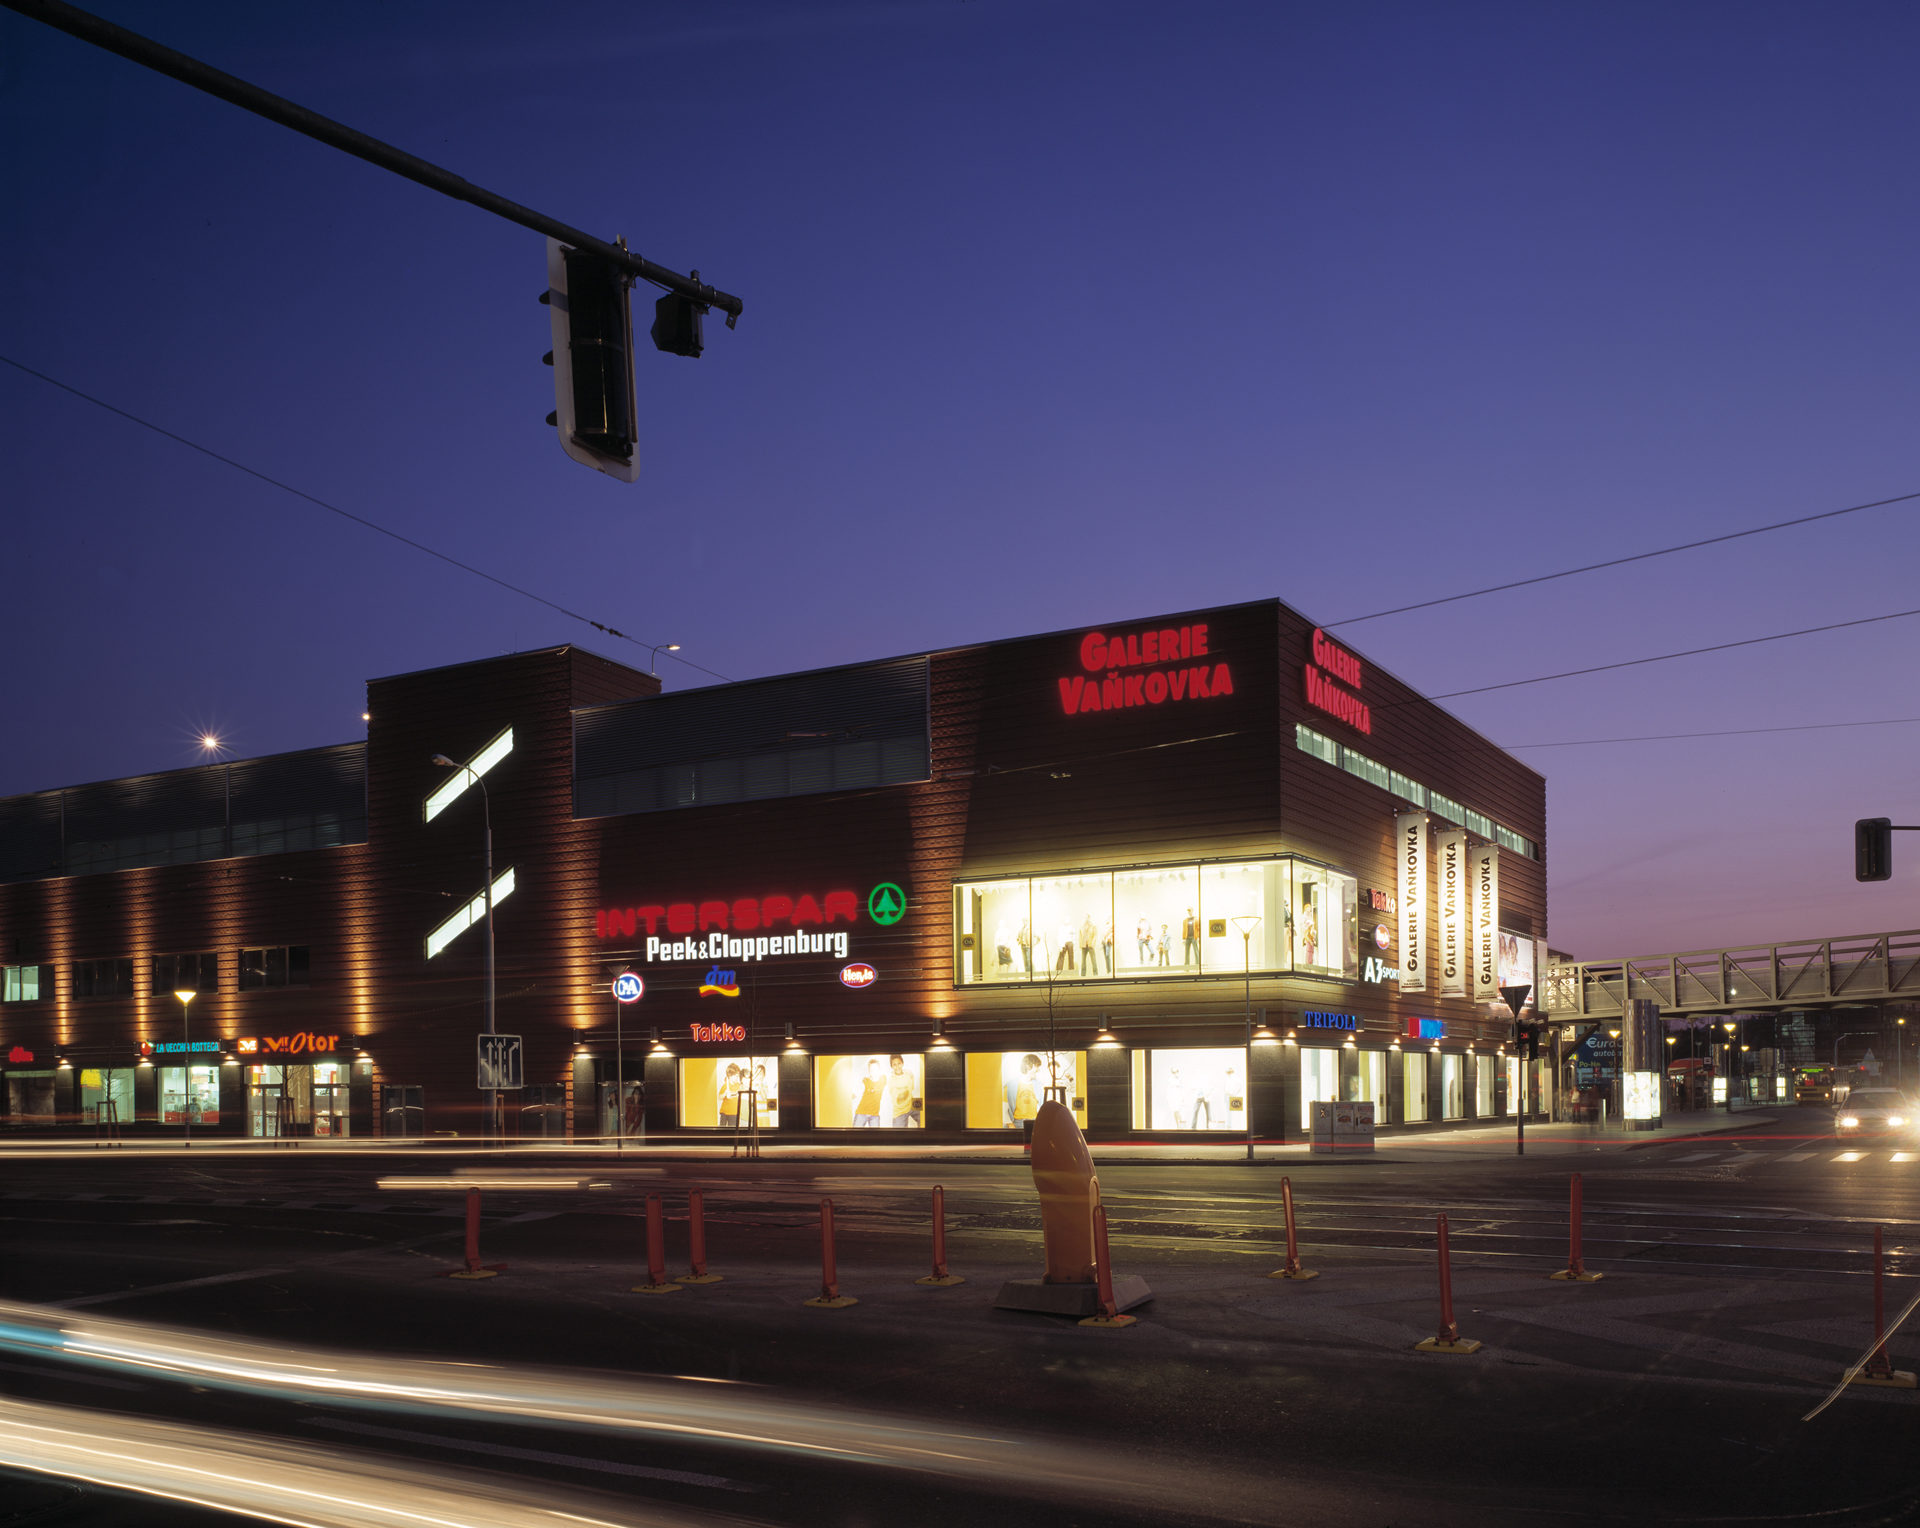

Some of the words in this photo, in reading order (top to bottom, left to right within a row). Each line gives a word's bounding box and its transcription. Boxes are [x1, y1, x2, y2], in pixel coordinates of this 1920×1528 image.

[1080, 624, 1209, 671] GALERIE
[1312, 627, 1362, 689] GALERIE
[1059, 663, 1234, 715] VAŇKOVKA
[1305, 664, 1371, 735] VAŇKOVKA
[595, 891, 858, 937] INTERSPAR
[646, 929, 848, 962] Peek&Cloppenburg
[1407, 911, 1418, 972] GALERIE
[1444, 922, 1456, 979] GALERIE
[1480, 931, 1491, 985] GALERIE
[705, 965, 736, 986] dm
[1364, 957, 1384, 984] A3
[690, 1022, 746, 1042] Takko
[1304, 1010, 1356, 1030] TRIPOLI
[156, 1043, 165, 1053] LA
[165, 1042, 190, 1053] VECCHIA
[191, 1041, 219, 1052] BOTTEGA
